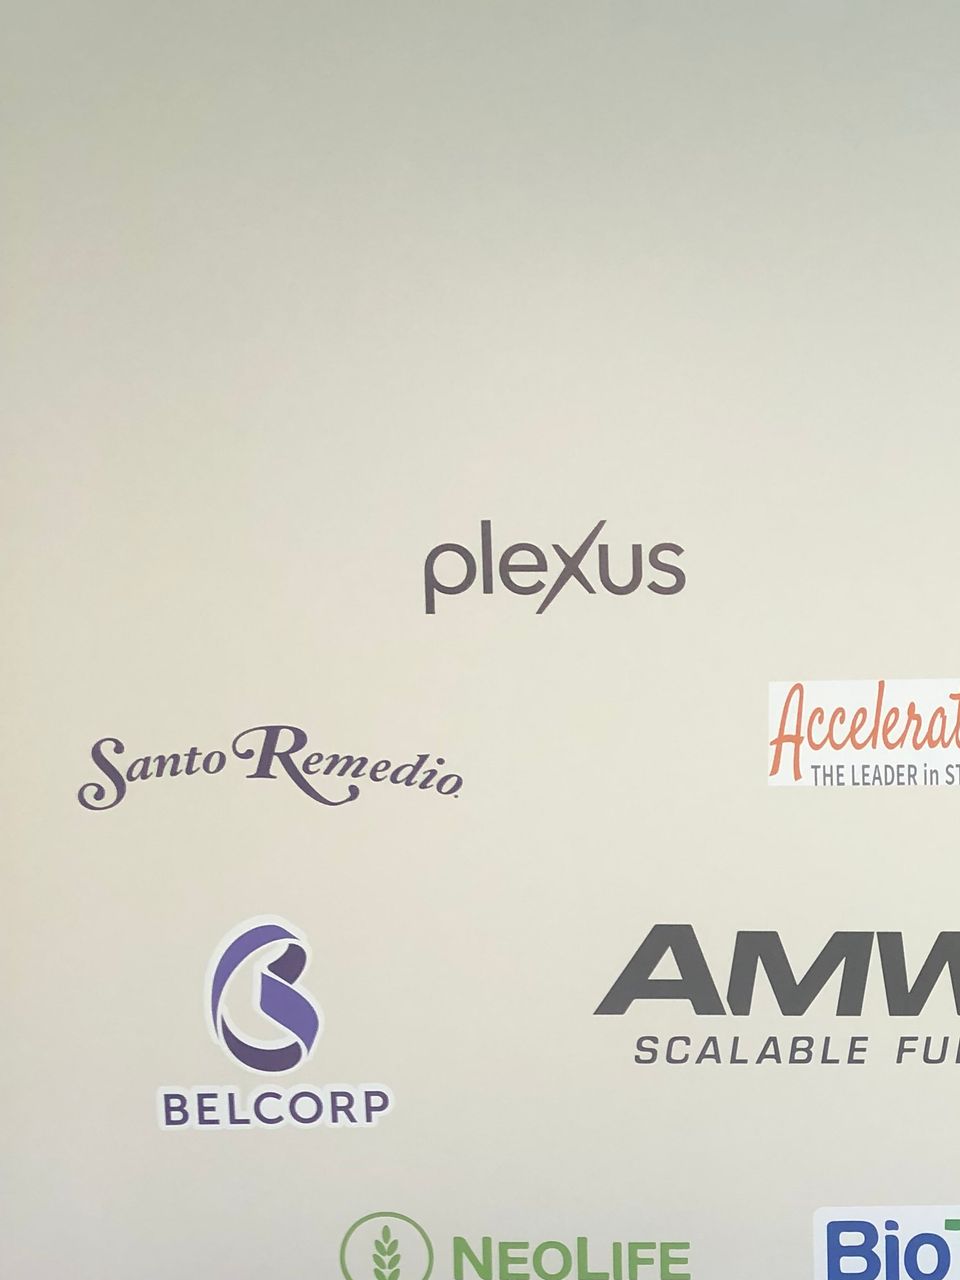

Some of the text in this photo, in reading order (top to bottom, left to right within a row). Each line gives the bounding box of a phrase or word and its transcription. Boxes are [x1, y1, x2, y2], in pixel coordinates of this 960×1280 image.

[423, 519, 687, 615] plexus
[77, 737, 227, 811] Santo
[810, 763, 847, 787] THE
[851, 763, 918, 787] LEADER
[923, 762, 940, 786] in
[634, 1034, 869, 1065] SCALABLE
[163, 1090, 390, 1126] BELCORP
